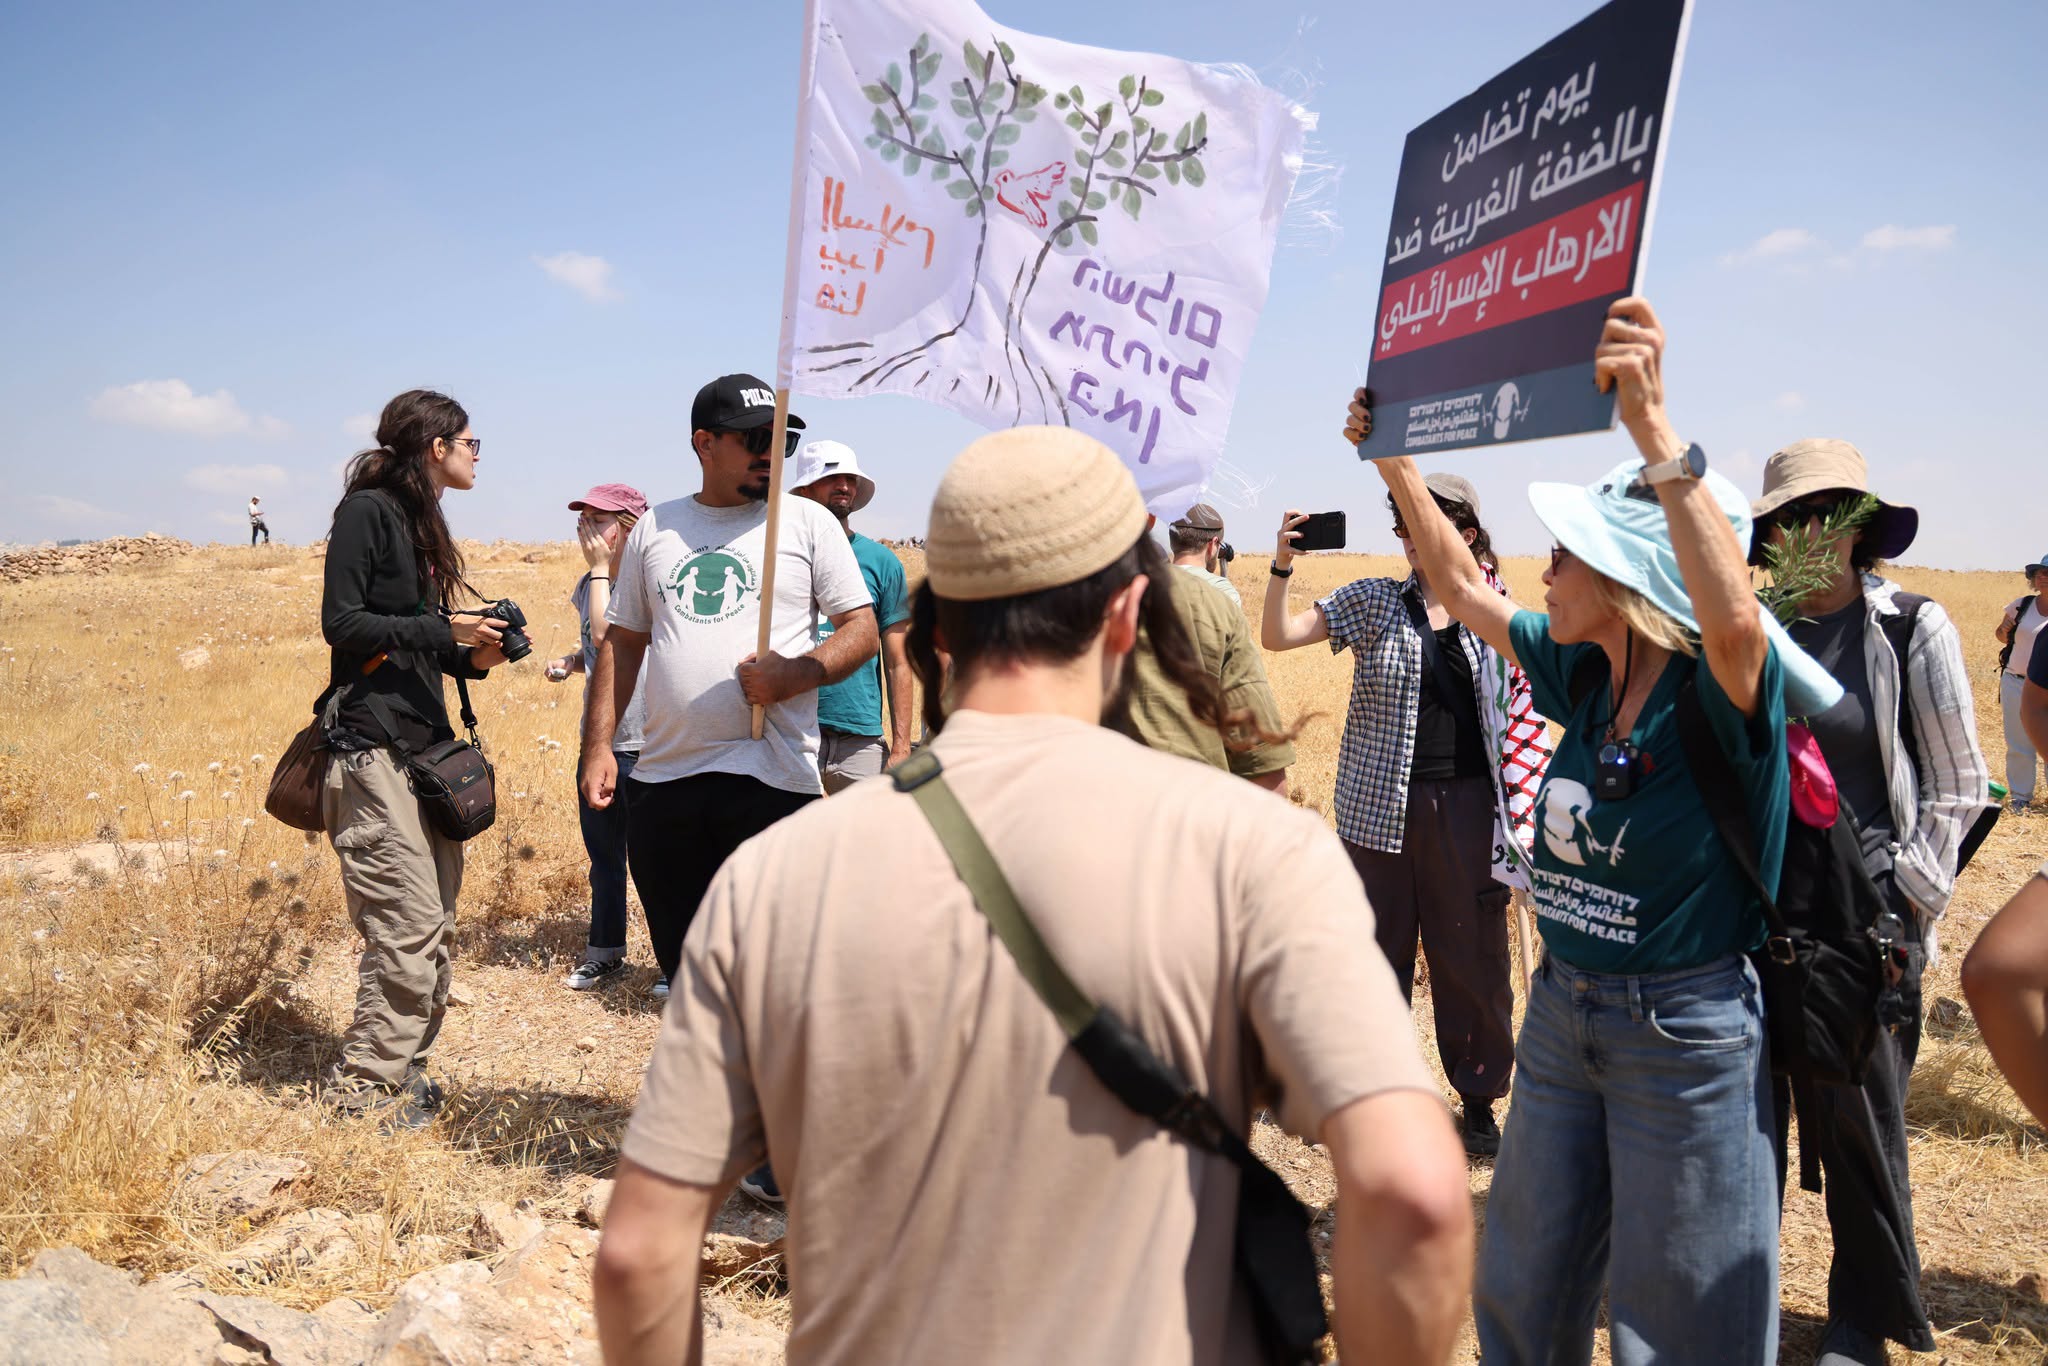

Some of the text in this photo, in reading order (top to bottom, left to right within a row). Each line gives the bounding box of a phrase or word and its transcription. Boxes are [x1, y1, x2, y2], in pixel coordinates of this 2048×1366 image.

[1441, 61, 1597, 183] يوم تضامن
[1388, 105, 1654, 265] بالضفة الغربية ضد
[1380, 195, 1633, 353] الارهاب الإسرائيلي
[739, 388, 776, 407] POLIC
[1456, 427, 1478, 440] PEACE
[674, 603, 746, 624] Combatants for Peace
[1567, 913, 1588, 933] FOR
[1588, 922, 1637, 944] PEACE
